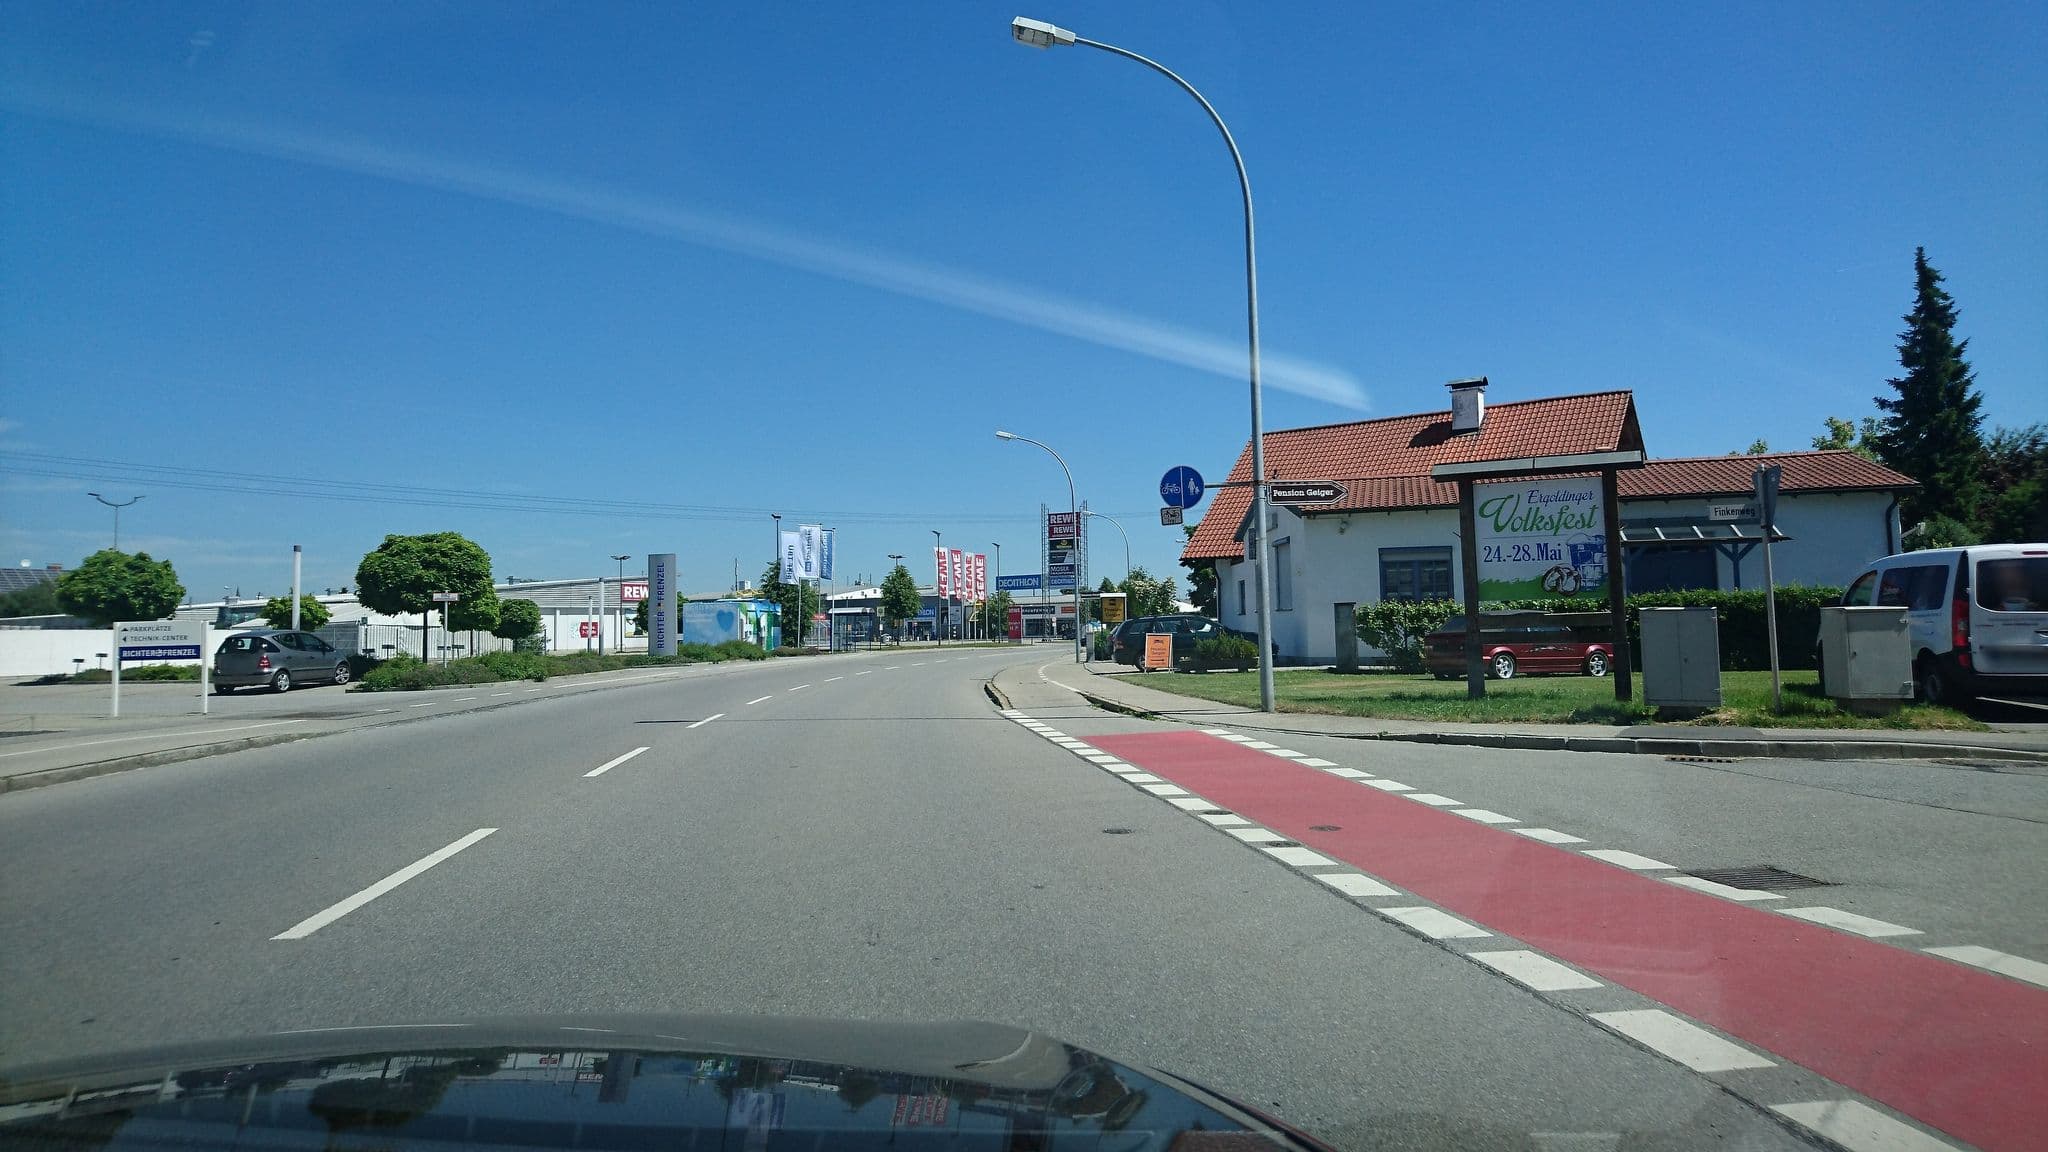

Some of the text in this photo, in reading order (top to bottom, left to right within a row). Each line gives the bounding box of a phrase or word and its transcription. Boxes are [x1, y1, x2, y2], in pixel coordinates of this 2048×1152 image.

[1273, 489, 1334, 498] Pension Geiger
[1527, 489, 1594, 507] Ergoldinger
[1478, 494, 1599, 536] Volksfest
[1714, 507, 1756, 518] Finkenweg
[657, 562, 665, 649] RICHTER FRENZEL
[122, 648, 197, 658] RICHTER FRENZEL
